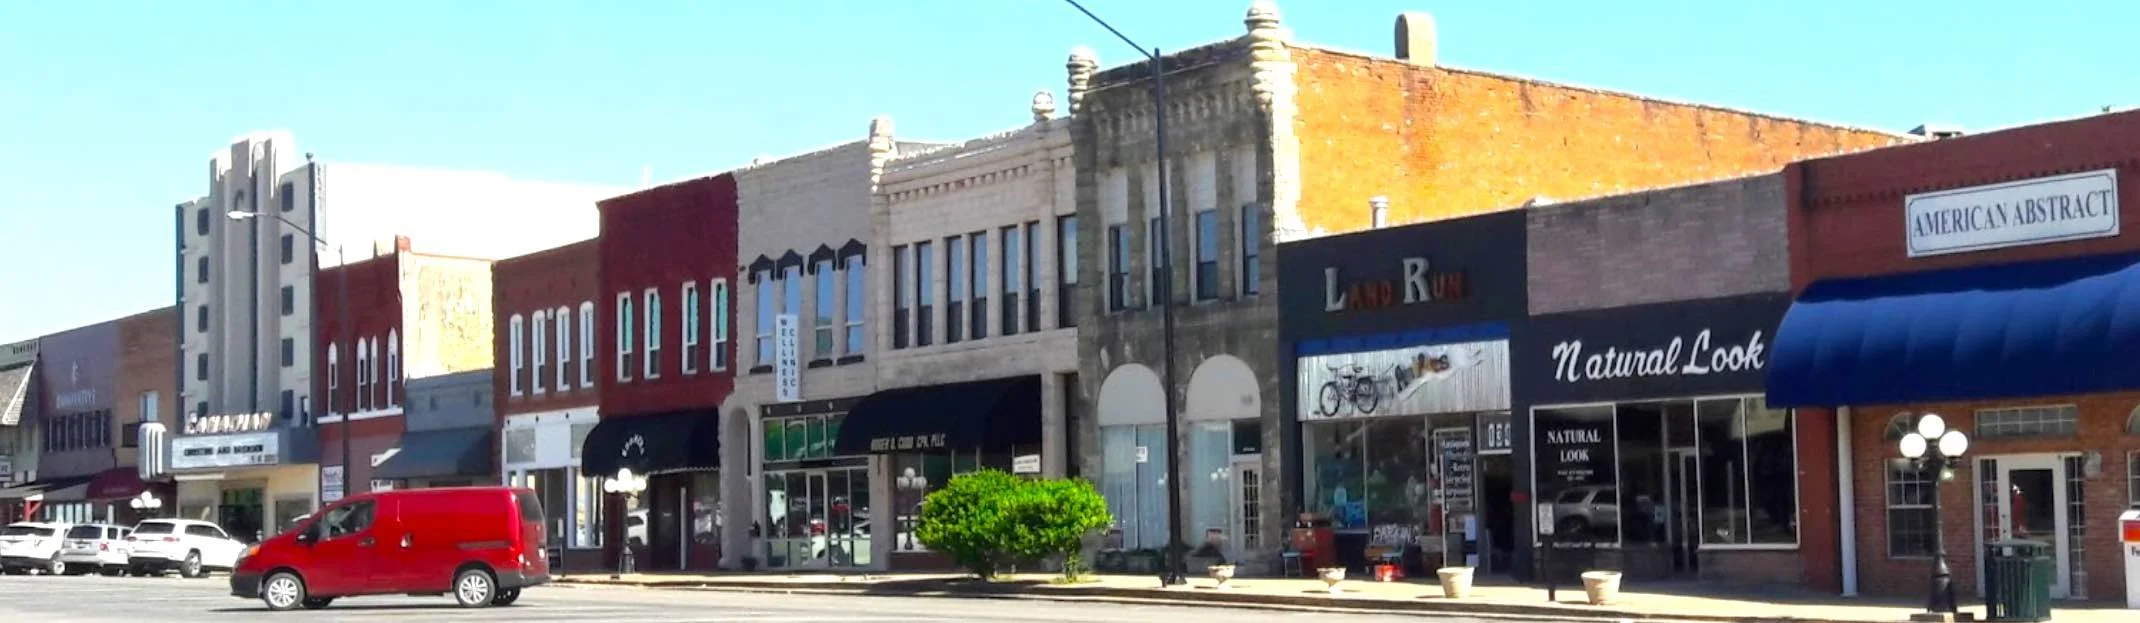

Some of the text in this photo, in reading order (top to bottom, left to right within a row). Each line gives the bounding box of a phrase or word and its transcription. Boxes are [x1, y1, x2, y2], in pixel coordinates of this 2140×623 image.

[1913, 189, 2111, 237] AMERICAN ABSTRACT
[780, 319, 789, 397] WELLNESS
[789, 328, 797, 387] CLINIC
[1552, 328, 1764, 383] Natural Look
[1547, 428, 1602, 444] NATURAL
[1560, 448, 1590, 463] LOOK
